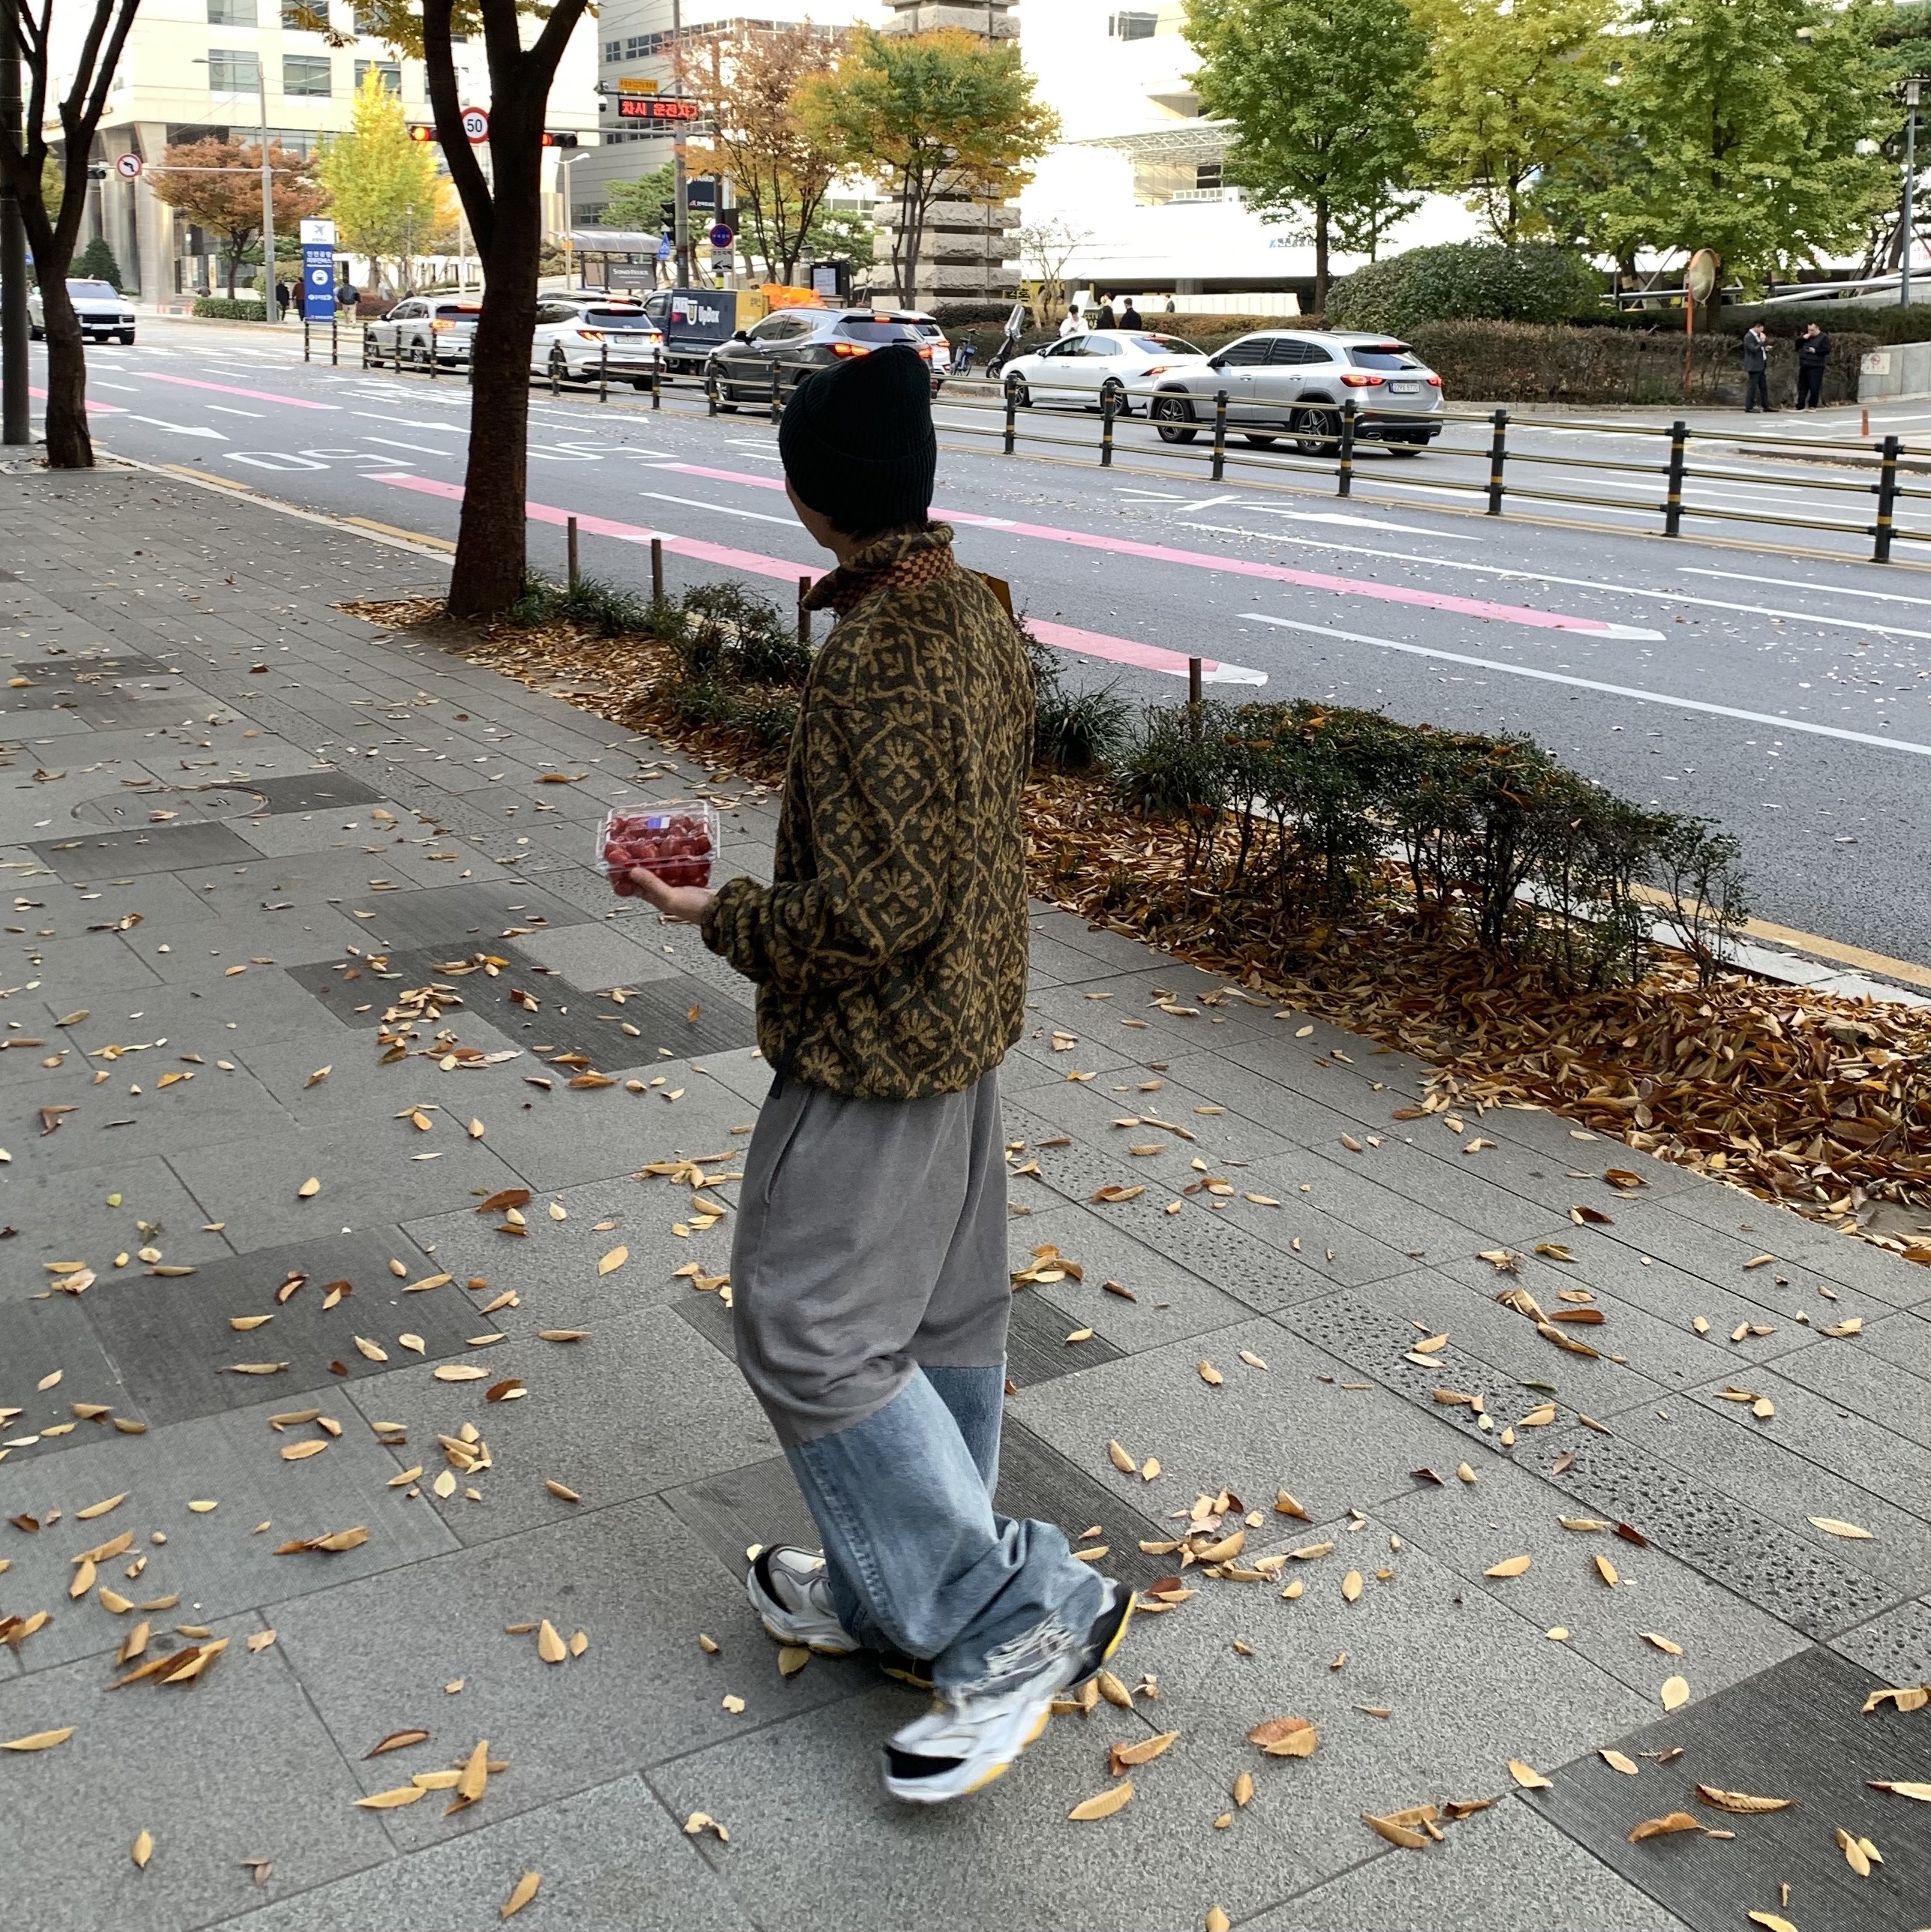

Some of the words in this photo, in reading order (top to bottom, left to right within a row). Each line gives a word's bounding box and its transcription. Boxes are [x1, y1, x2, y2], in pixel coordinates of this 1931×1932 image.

[621, 100, 648, 115] 차시
[467, 118, 482, 133] 50
[698, 305, 720, 326] UpBox
